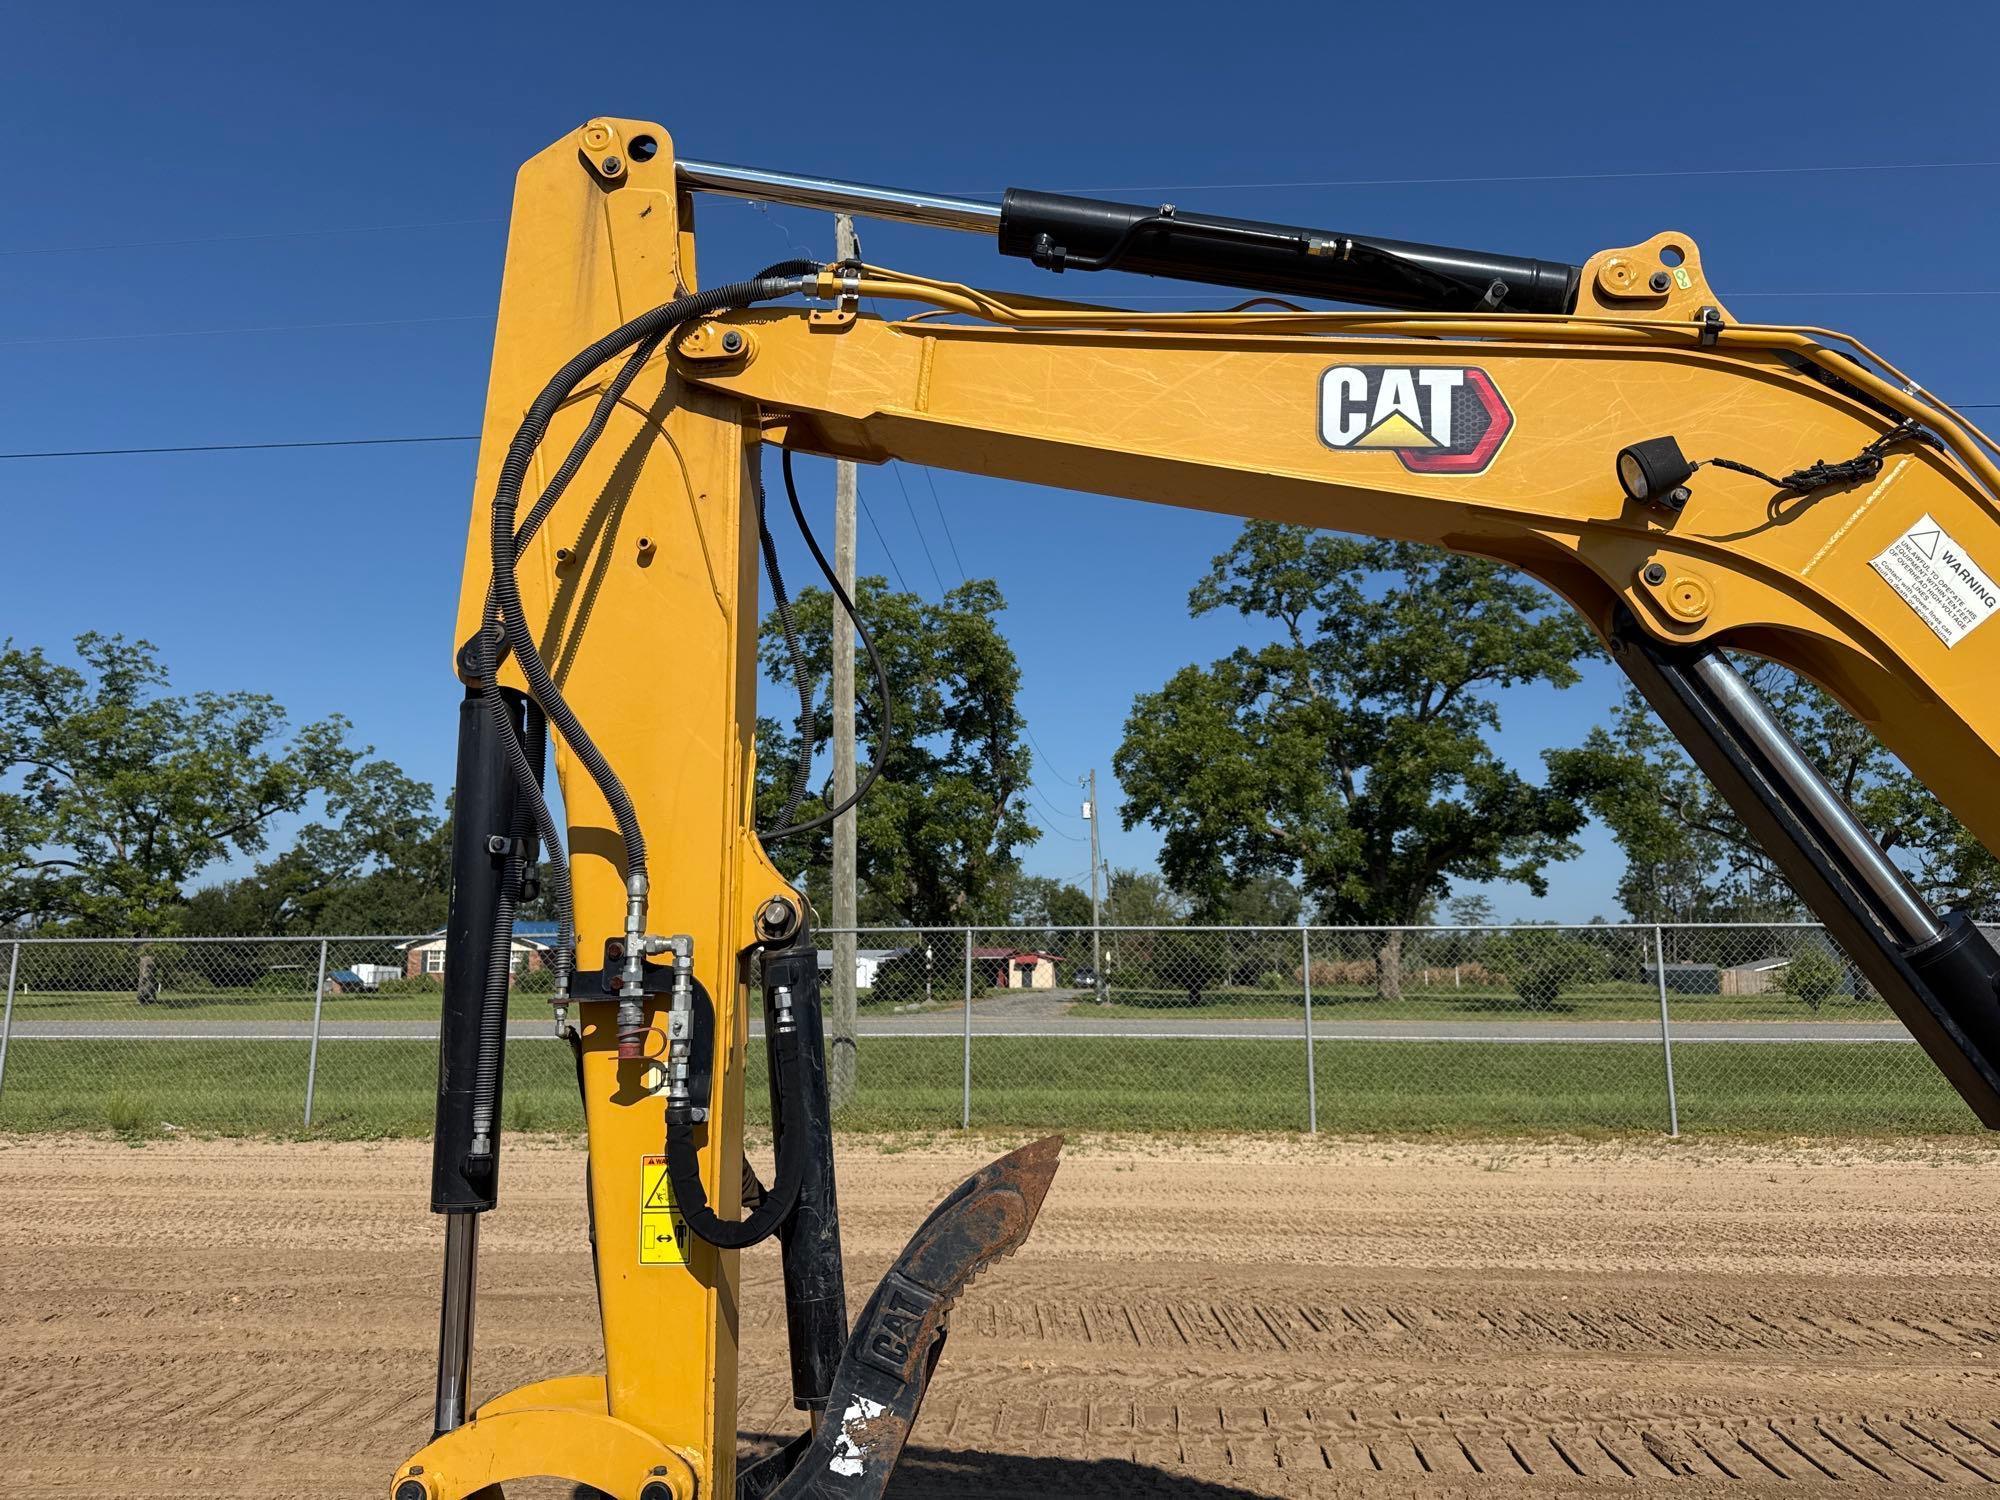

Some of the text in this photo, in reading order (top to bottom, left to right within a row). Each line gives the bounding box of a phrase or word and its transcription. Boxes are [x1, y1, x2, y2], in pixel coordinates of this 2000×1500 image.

[1322, 366, 1464, 447] CAT
[1872, 561, 1889, 577] result
[1893, 583, 1909, 599] death
[1881, 560, 1953, 636] Contact with power lines can
[1889, 549, 1967, 630] OF OVERHEAD HIGH-VOLTAGE
[1895, 544, 1973, 625] EQUIPMENT WITHIN TEN FEET
[1901, 540, 1930, 573] UNLAWFUL
[1930, 571, 1939, 580] TO
[1963, 606, 1978, 621] HIS
[1911, 582, 1930, 601] LINES
[1942, 550, 1997, 609] WARNING
[872, 1290, 926, 1365] CAT
